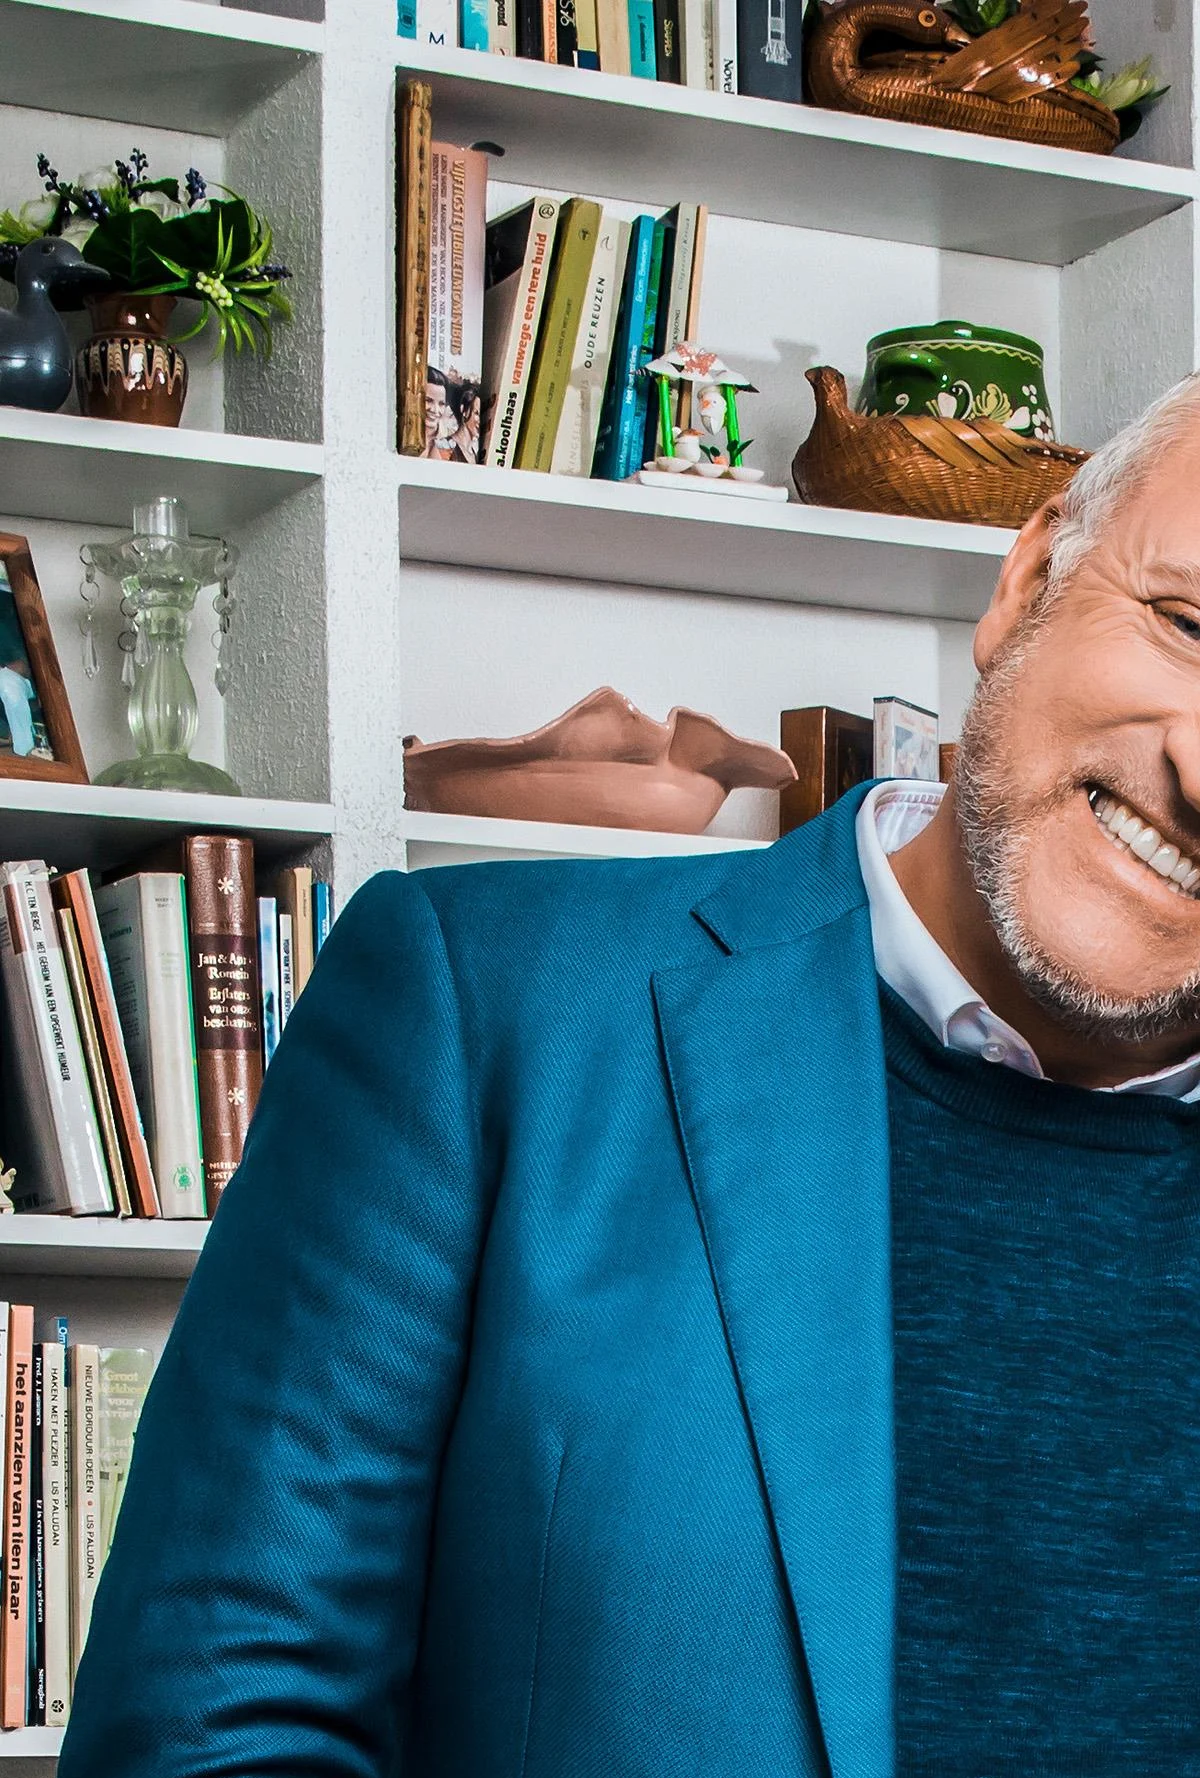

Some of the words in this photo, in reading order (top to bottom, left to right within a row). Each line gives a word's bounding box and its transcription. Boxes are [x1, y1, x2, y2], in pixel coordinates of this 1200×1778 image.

[532, 233, 547, 266] huid
[528, 266, 541, 295] tere
[524, 295, 536, 322] een
[590, 277, 606, 328] REUZEN
[511, 323, 531, 385] vanwege
[584, 330, 598, 369] OUDE
[496, 391, 518, 468] a.koolhaas
[27, 897, 37, 912] TEN
[30, 910, 42, 931] BERGE
[36, 941, 46, 955] HET
[198, 953, 217, 967] Jan
[38, 956, 51, 982] GEHEIM
[43, 983, 54, 998] VAN
[47, 998, 57, 1012] EEN
[208, 1005, 228, 1014] van
[50, 1013, 65, 1050] OPGEWEKT
[56, 1051, 71, 1082] HUMEUR
[16, 1363, 28, 1396] het
[51, 1368, 59, 1402] HAKEN
[85, 1365, 93, 1403] NIEUWE
[51, 1404, 59, 1424] MET
[13, 1400, 27, 1486] aanzien
[51, 1428, 59, 1467] PLEZIER
[12, 1495, 22, 1528] van
[52, 1498, 60, 1546] PALUDAN
[86, 1514, 94, 1528] LIS
[11, 1531, 23, 1570] tien
[9, 1573, 23, 1620] jaar
